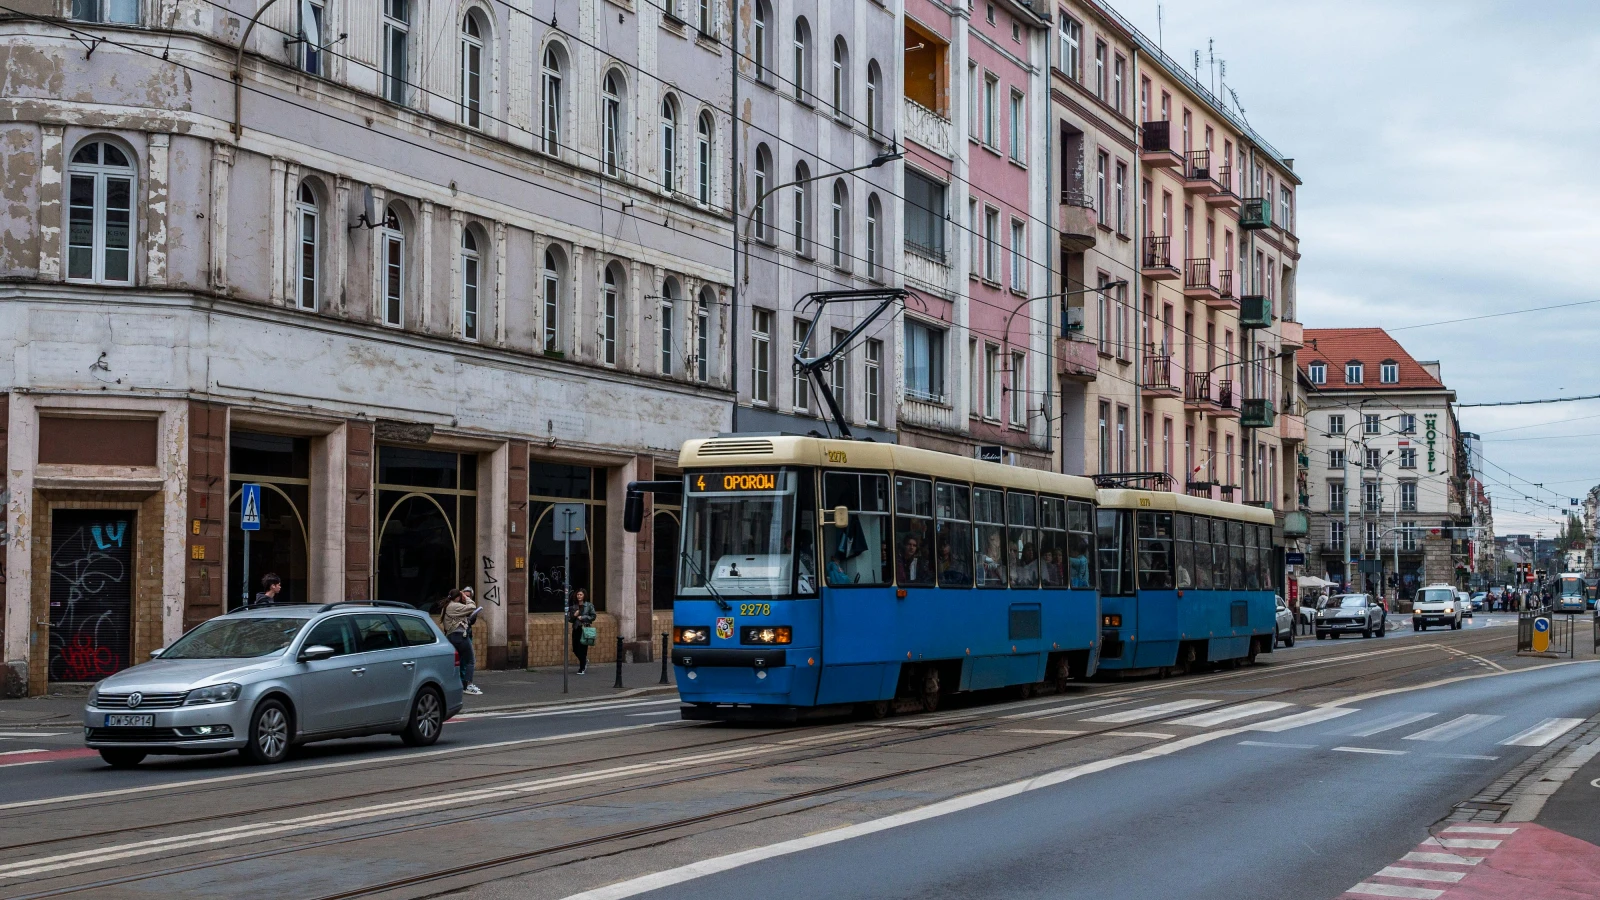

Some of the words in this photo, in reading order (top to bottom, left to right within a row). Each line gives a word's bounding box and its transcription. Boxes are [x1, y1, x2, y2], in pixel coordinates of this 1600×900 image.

[1425, 419, 1437, 473] HOTEL
[828, 450, 848, 464] 2278
[696, 474, 706, 491] 4
[723, 473, 775, 490] OPORÓW
[740, 603, 771, 616] 2278
[110, 715, 122, 726] DW
[123, 715, 151, 726] 5KP14
